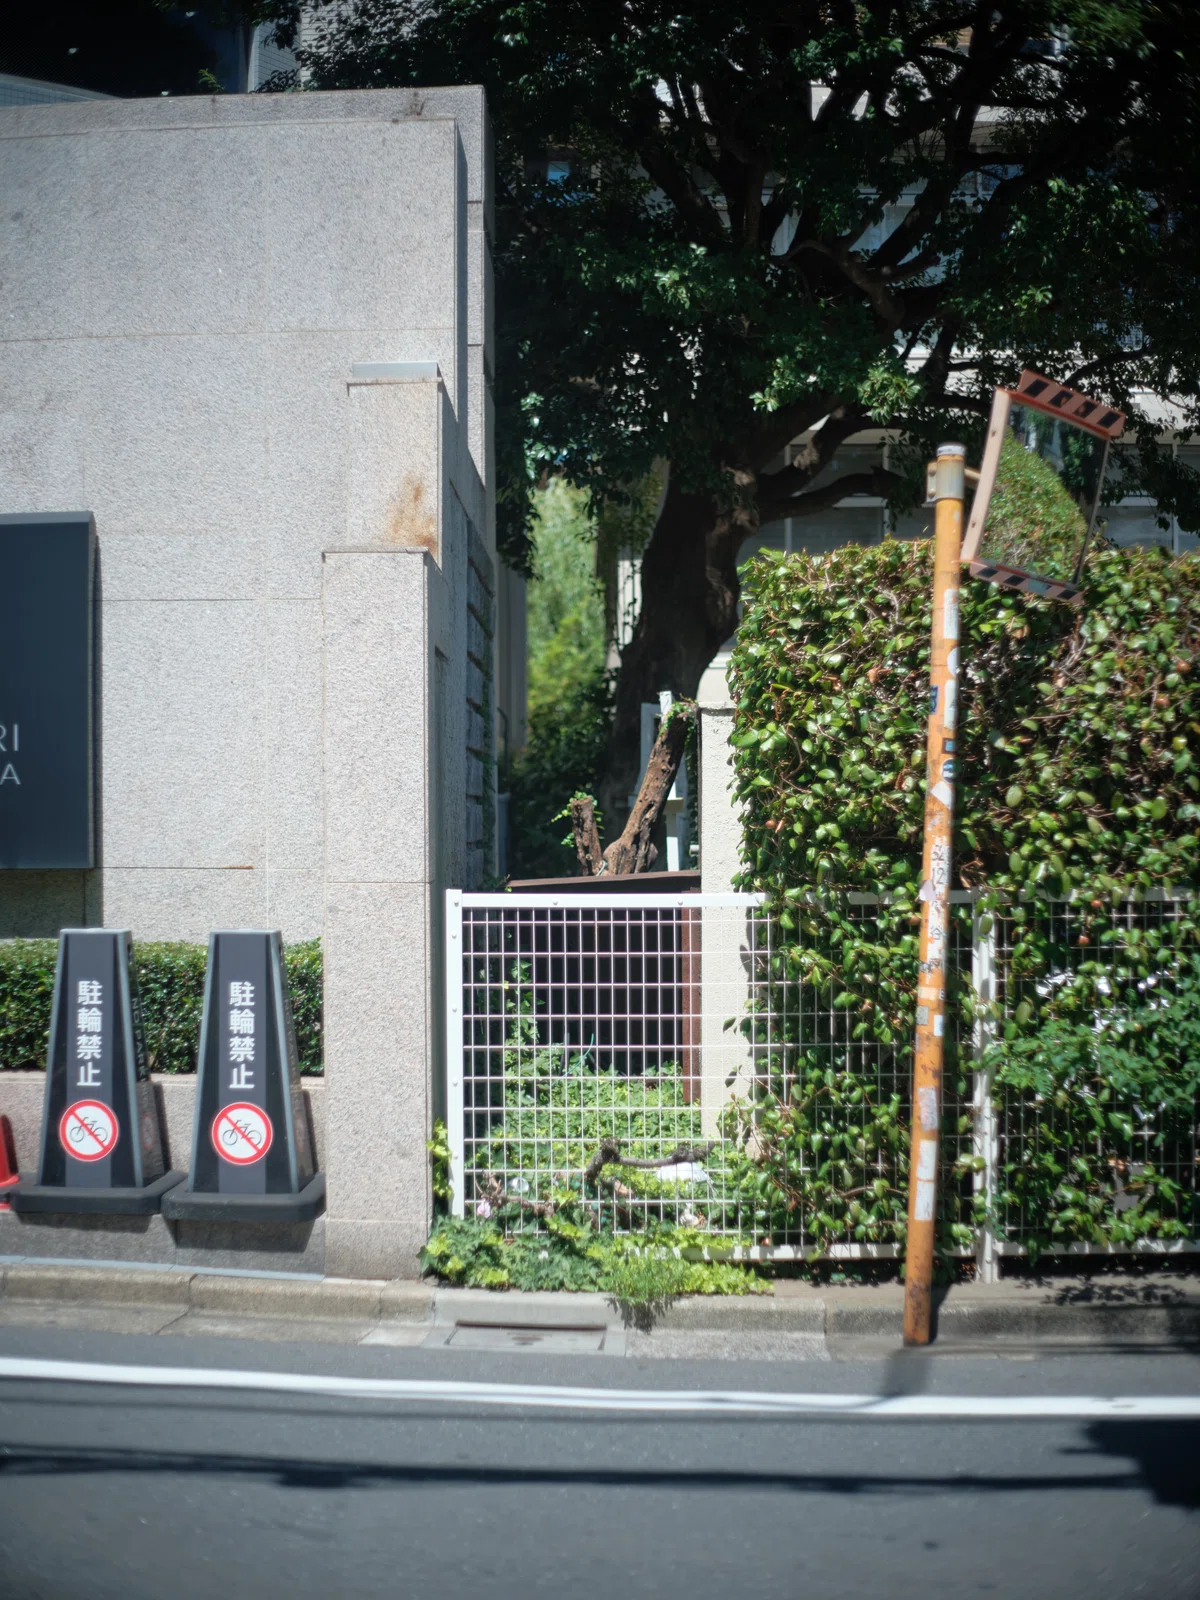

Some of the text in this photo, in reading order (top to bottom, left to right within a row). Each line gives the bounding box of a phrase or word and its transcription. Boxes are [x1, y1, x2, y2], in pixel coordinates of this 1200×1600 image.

[0, 763, 21, 786] A
[77, 980, 103, 1087] 駐輪禁止
[229, 981, 256, 1090] 駐輪禁止
